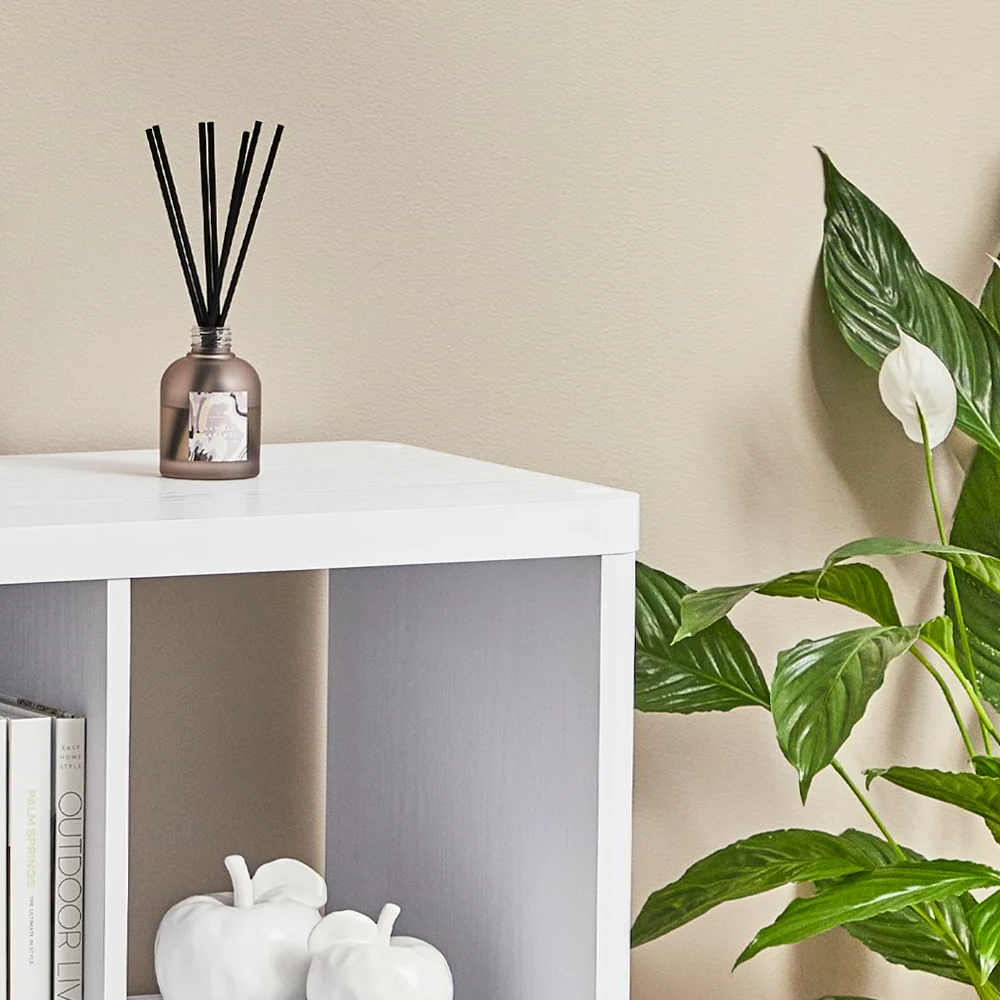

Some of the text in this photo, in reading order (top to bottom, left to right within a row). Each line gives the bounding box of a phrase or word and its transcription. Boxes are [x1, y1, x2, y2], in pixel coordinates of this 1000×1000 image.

[26, 789, 36, 889] PALM SPRINGS
[57, 791, 83, 949] OUTDOOR
[29, 938, 35, 946] IN
